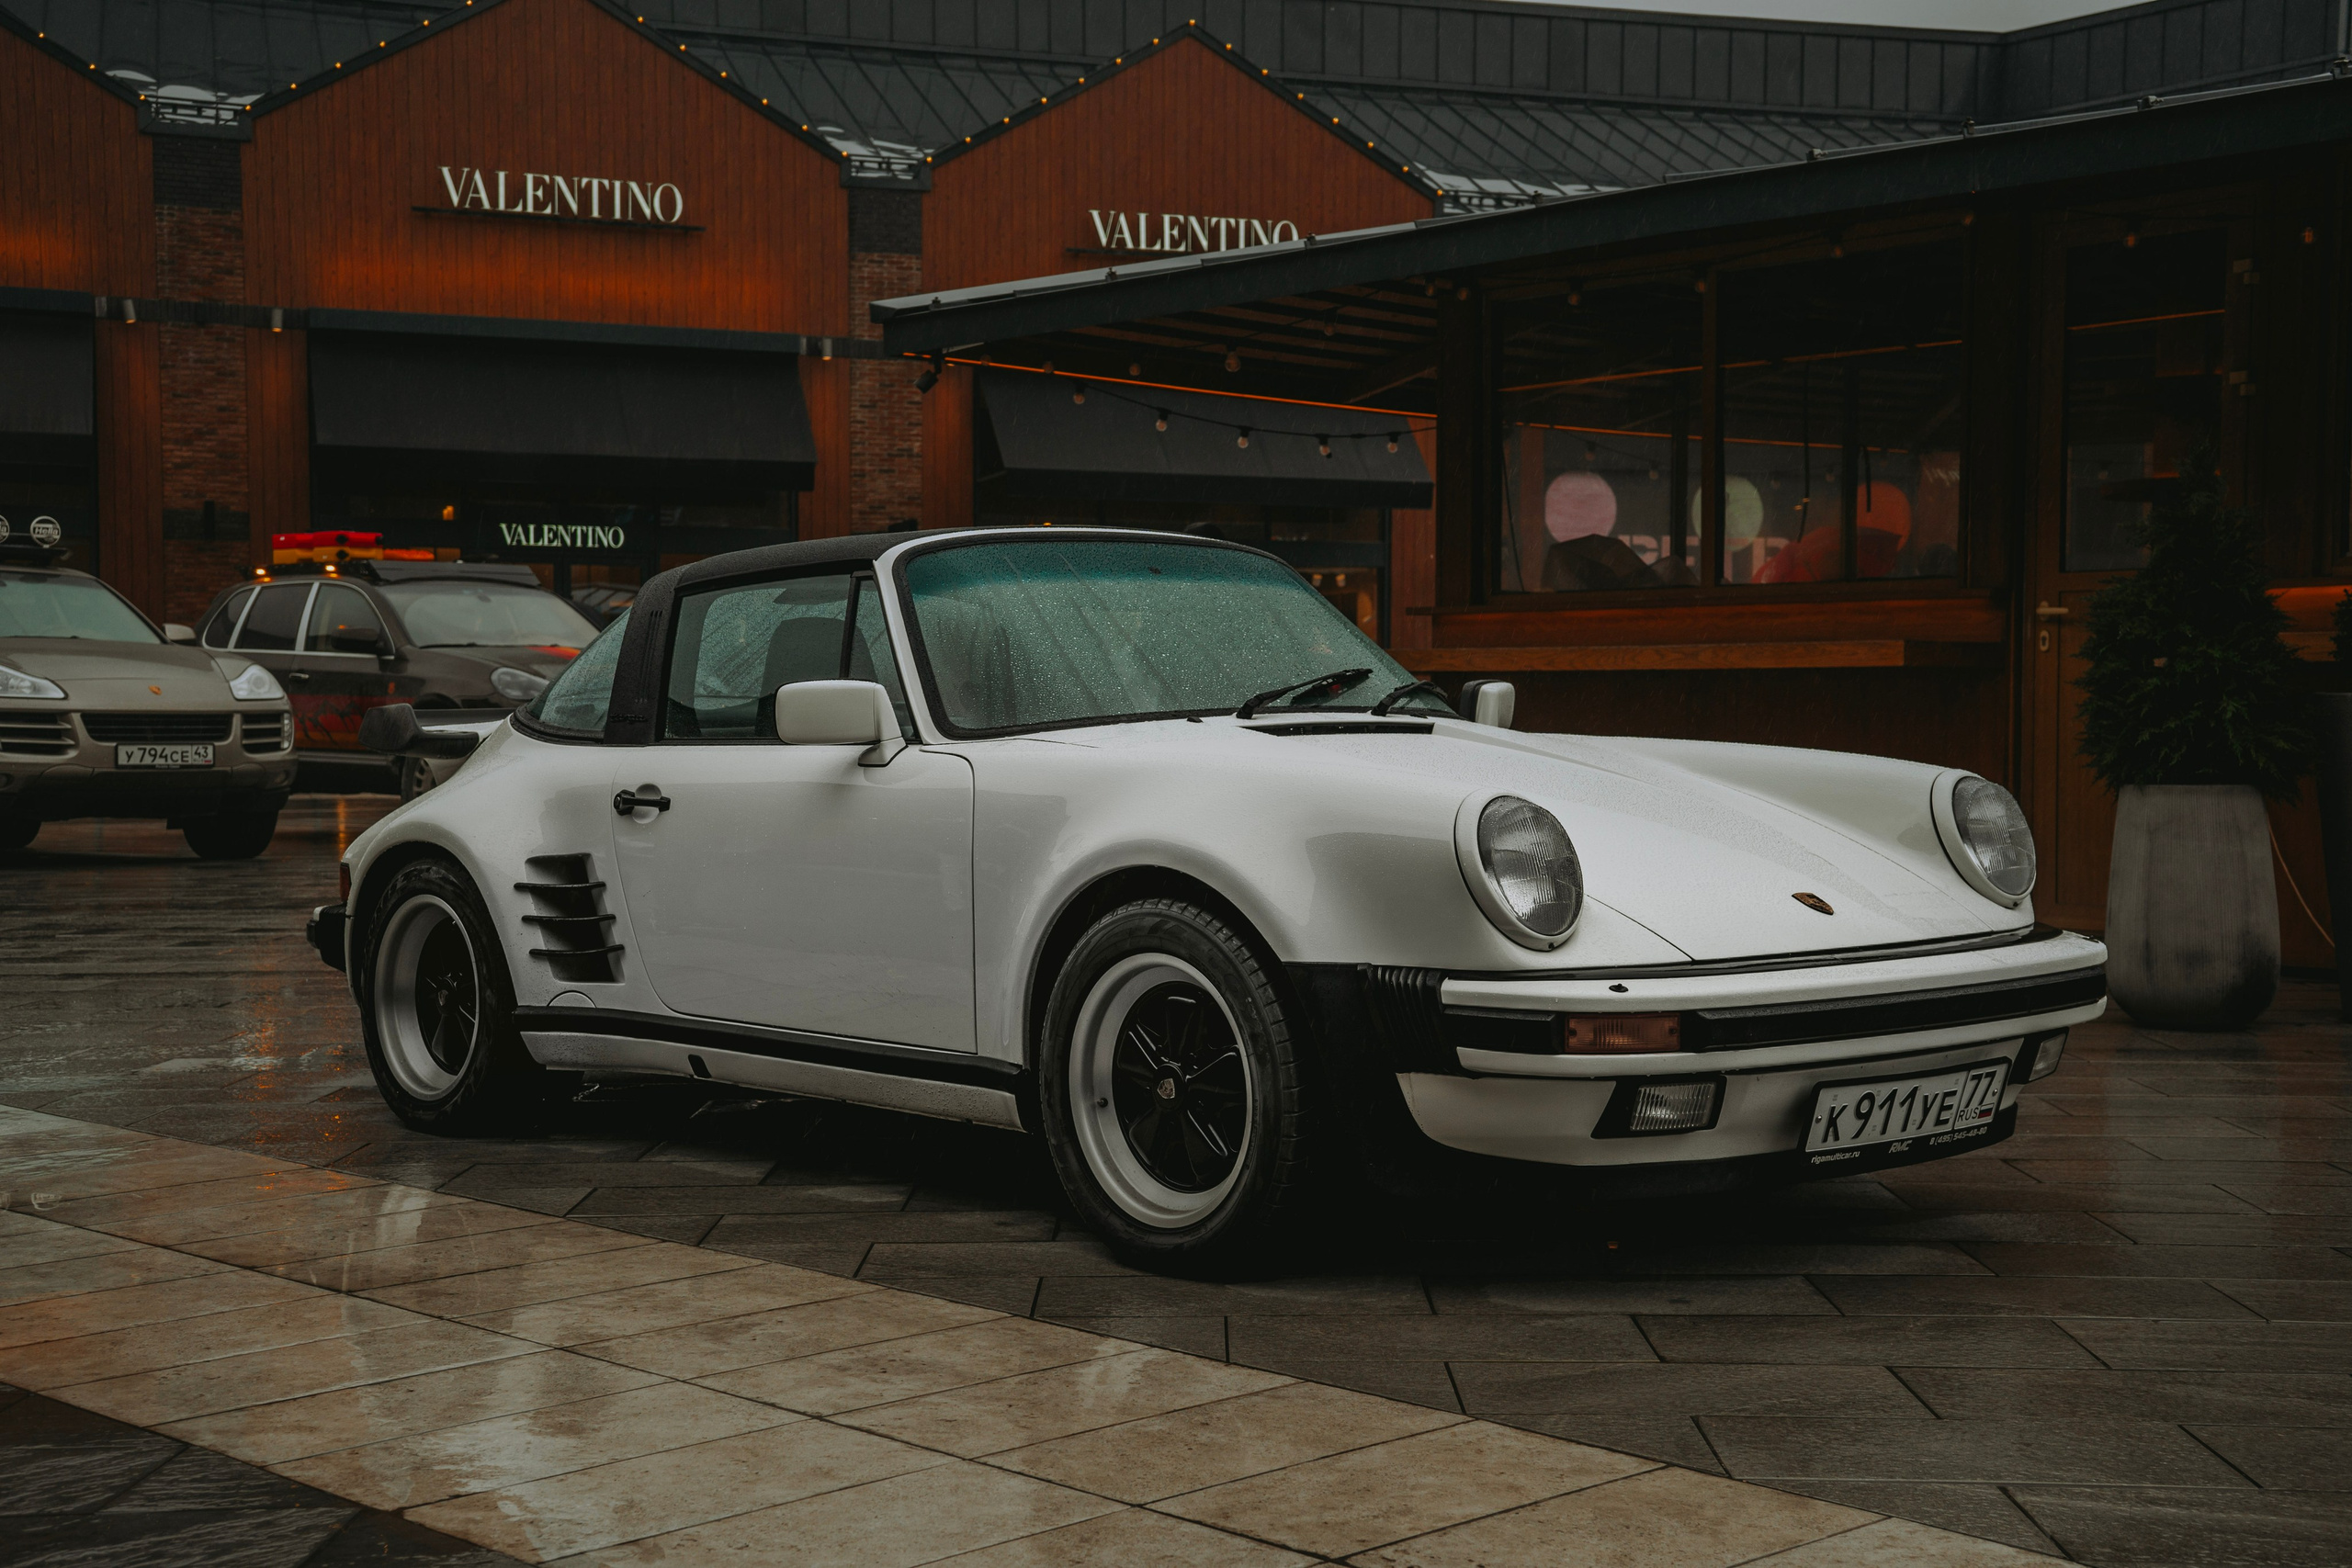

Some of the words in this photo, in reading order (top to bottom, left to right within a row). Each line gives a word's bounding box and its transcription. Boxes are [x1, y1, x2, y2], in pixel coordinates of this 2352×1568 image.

[438, 165, 684, 223] VALENTINO
[1088, 209, 1300, 253] VALENTINO
[33, 525, 60, 536] Hella
[499, 522, 626, 549] VALENTINO
[194, 746, 209, 759] 43
[1964, 1070, 1997, 1109] 77
[1957, 1107, 1979, 1123] RUS
[1810, 1150, 1861, 1165] rigamulticar.ru
[1888, 1139, 1913, 1154] RMC
